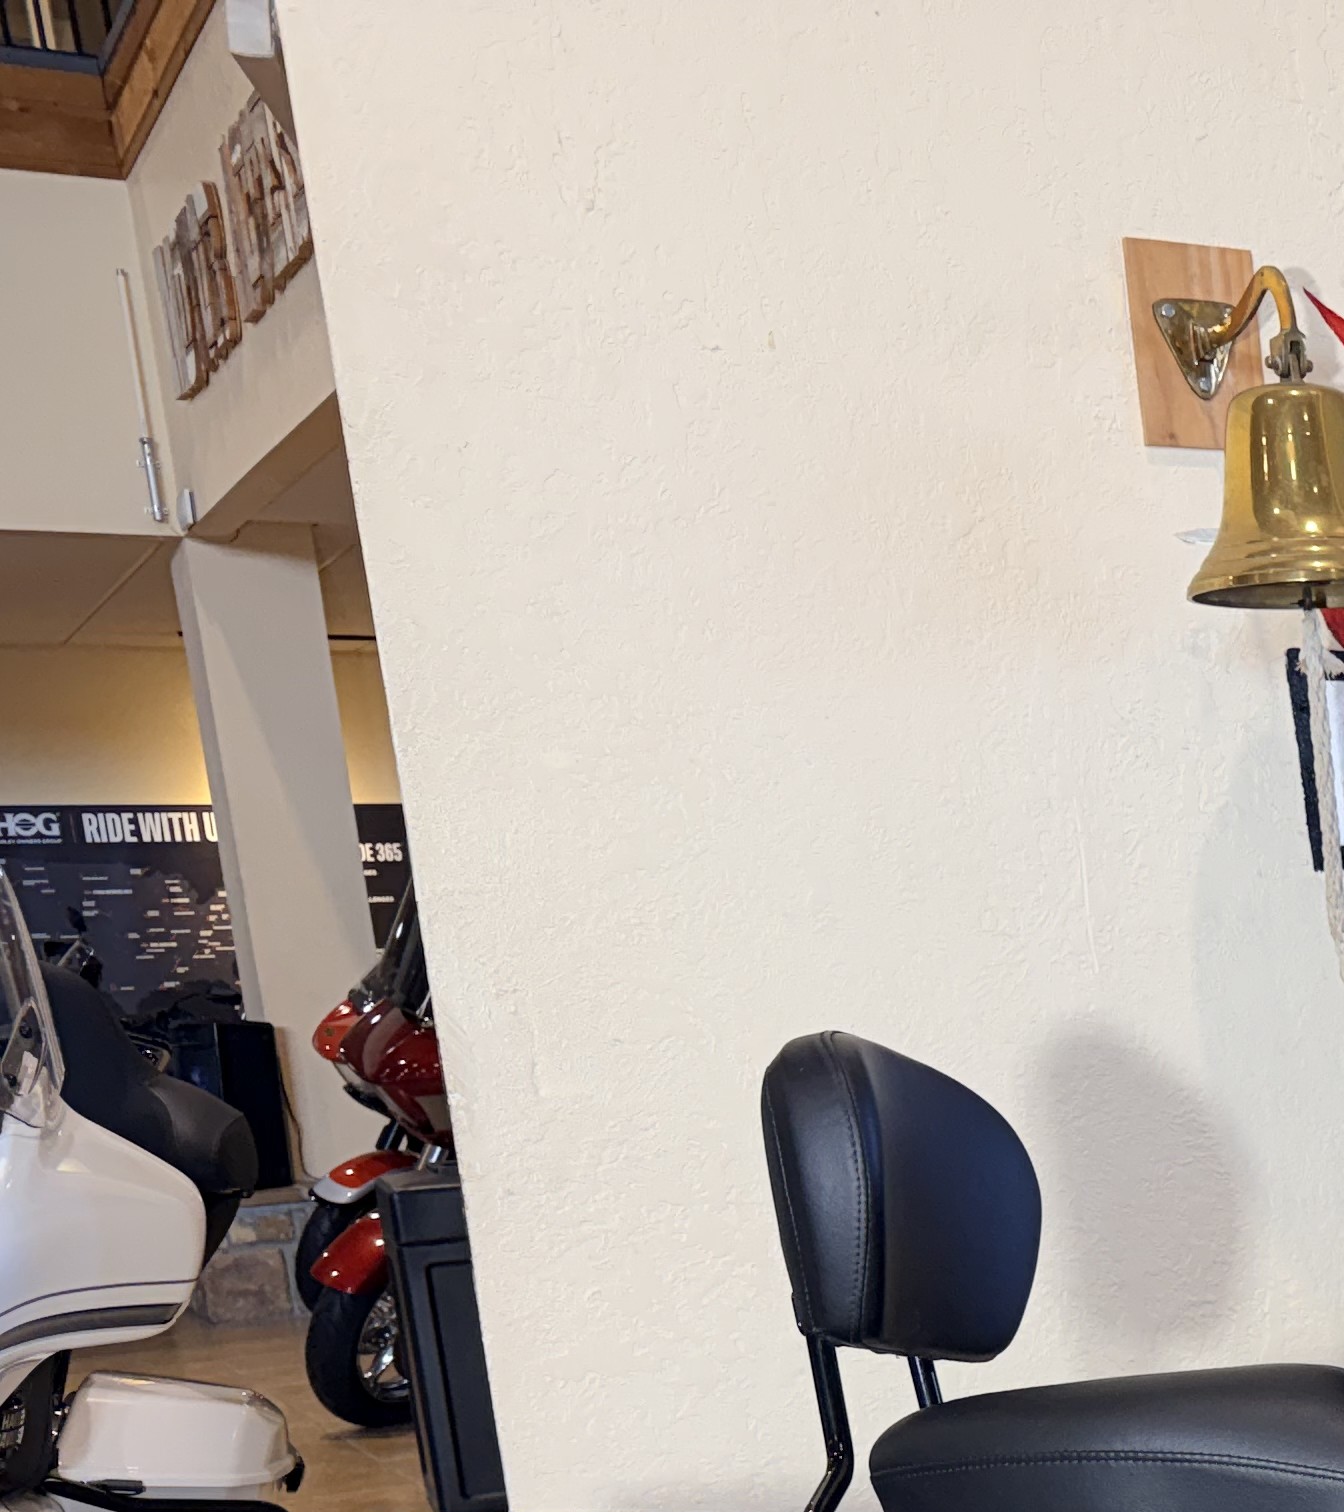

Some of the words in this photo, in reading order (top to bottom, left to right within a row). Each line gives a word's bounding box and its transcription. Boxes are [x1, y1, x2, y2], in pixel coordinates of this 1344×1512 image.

[81, 812, 138, 843] RIDE
[136, 812, 200, 843] WITH
[202, 811, 218, 842] U
[375, 842, 402, 862] 365
